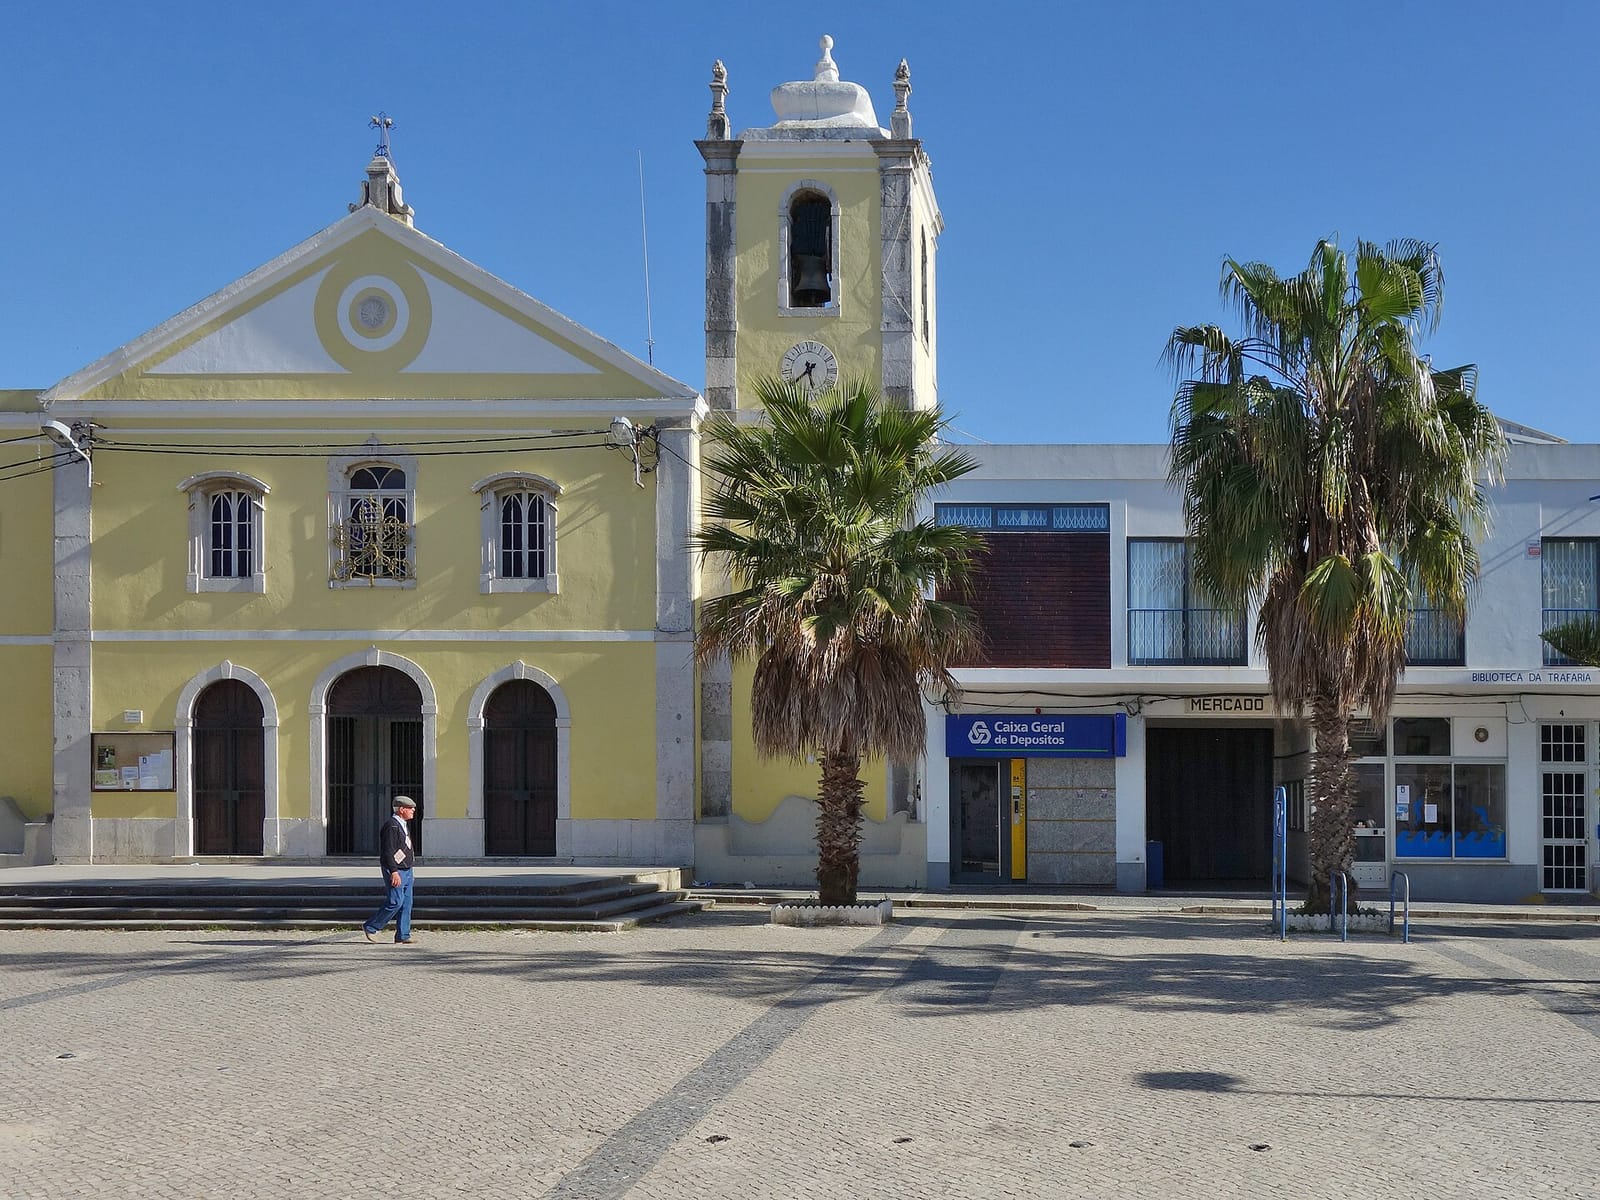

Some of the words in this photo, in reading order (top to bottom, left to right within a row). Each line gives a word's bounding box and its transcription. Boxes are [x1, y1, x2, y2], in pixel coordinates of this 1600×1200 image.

[1472, 672, 1523, 682] BIBLIOTECA
[1528, 672, 1542, 682] DA
[1548, 672, 1592, 682] TRAFARIA
[1191, 698, 1264, 711] MERCADO
[994, 721, 1029, 733] Caixa
[1031, 721, 1066, 733] Geral
[994, 735, 1008, 745] de
[1010, 735, 1065, 747] Depositos
